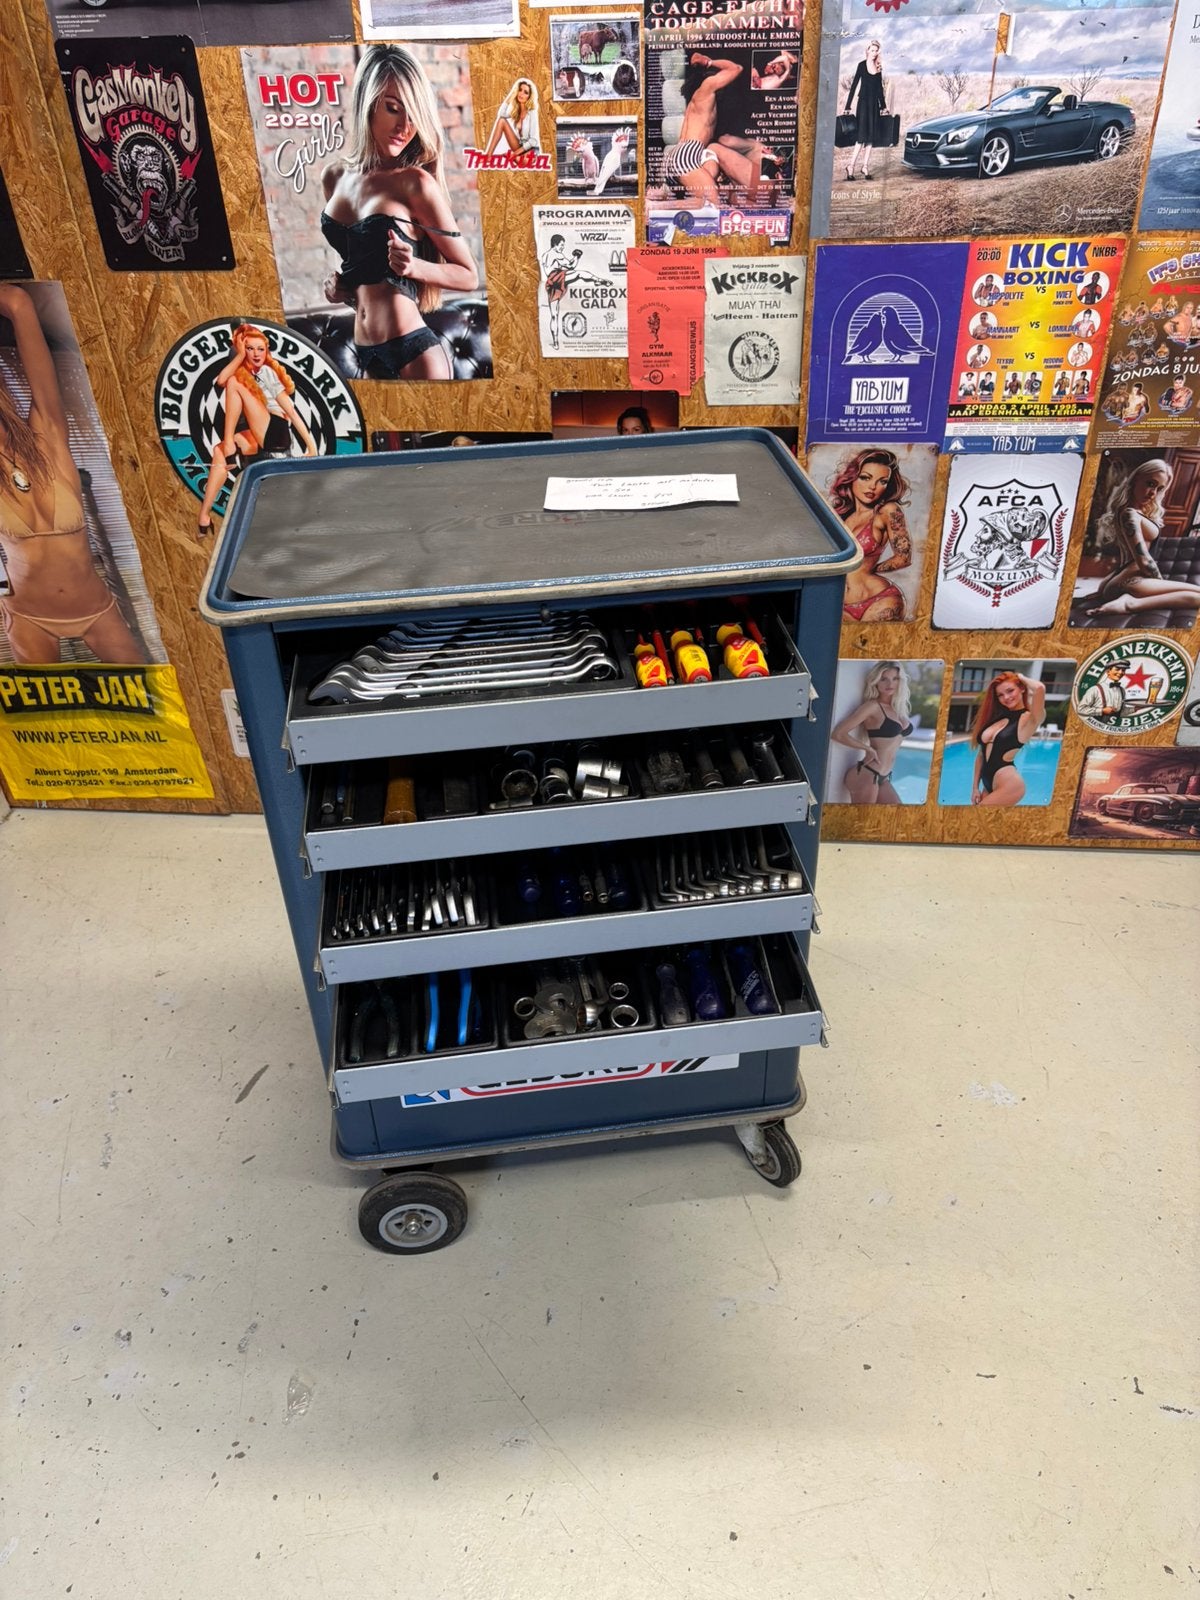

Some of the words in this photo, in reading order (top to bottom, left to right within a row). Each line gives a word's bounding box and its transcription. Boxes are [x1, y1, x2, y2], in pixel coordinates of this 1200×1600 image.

[651, 15, 798, 30] TOURNAMENT
[659, 34, 684, 42] APRIL
[687, 33, 703, 41] 1996
[705, 32, 768, 41] ZUIDOOST-HAL
[770, 31, 800, 40] EMMEN
[258, 73, 344, 106] HOT
[106, 108, 177, 142] Garage
[264, 113, 322, 127] 2020
[274, 114, 345, 193] Girls
[538, 209, 631, 219] PROGRAMMA
[1077, 206, 1123, 215] Mercedes-Benz
[754, 219, 785, 233] FUN
[640, 248, 672, 256] ZONDAG
[1008, 242, 1091, 268] KICK
[1092, 246, 1117, 257] NKBB
[711, 270, 799, 295] KICKBOX
[1003, 270, 1085, 285] BOXING
[569, 288, 627, 299] KICKBOX
[1035, 286, 1047, 294] VS
[581, 299, 617, 309] GALA
[729, 301, 756, 310] MUAY
[757, 300, 781, 309] THAI
[1029, 321, 1040, 329] VS
[1024, 352, 1035, 360] VS
[161, 329, 234, 424] BIGGER
[262, 329, 351, 420] SPARK
[1112, 364, 1169, 385] ZONDAG
[1173, 363, 1181, 374] 8
[855, 380, 879, 401] YAB
[880, 380, 904, 401] YUM
[1028, 408, 1092, 416] AMSTERDAM
[992, 436, 1012, 451] YAB
[1015, 436, 1037, 451] YUM
[977, 495, 1044, 506] AFCA
[969, 570, 1033, 581] MOKUM
[0, 675, 85, 708] PETER
[94, 674, 150, 709] JAN
[1121, 707, 1165, 727] BIER
[13, 730, 167, 744] WWW.PETERJAN.NL
[34, 767, 61, 776] Albert
[124, 766, 178, 776] Amsterdam
[45, 778, 105, 787] 020-6735421
